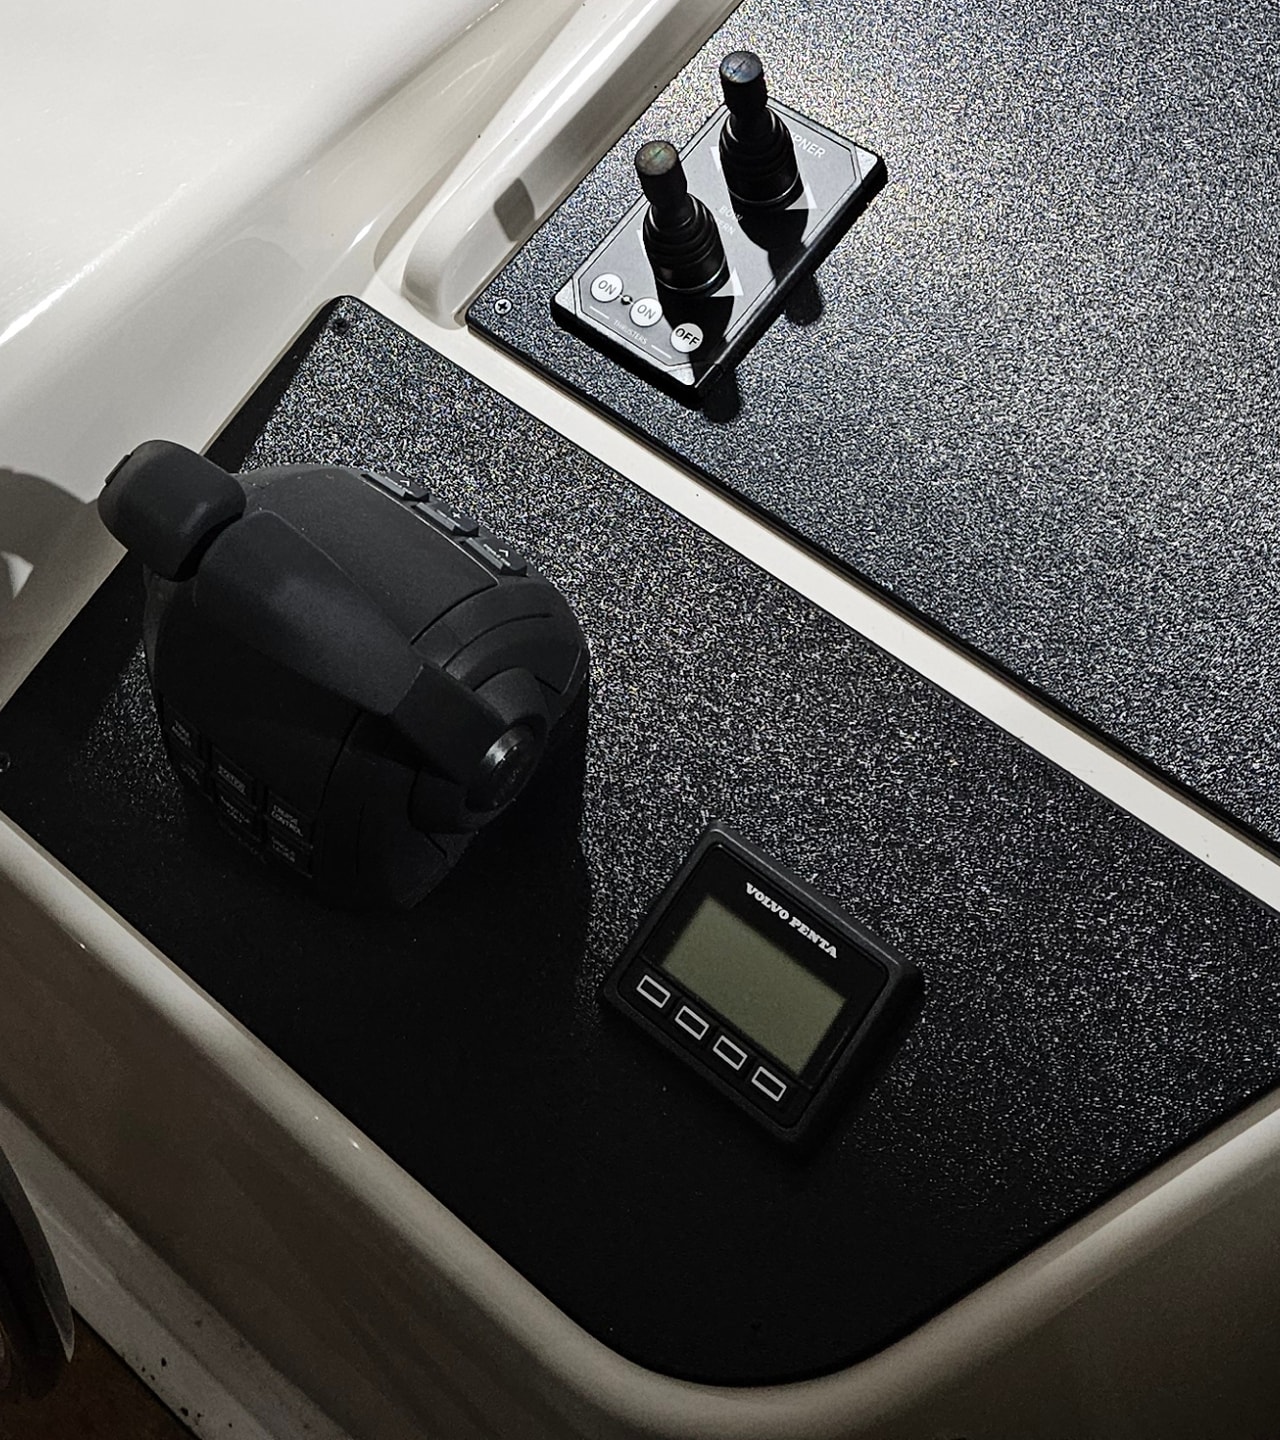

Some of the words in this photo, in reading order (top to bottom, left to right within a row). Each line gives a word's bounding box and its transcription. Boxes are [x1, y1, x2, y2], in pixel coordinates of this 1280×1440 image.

[597, 278, 617, 296] ON
[636, 303, 657, 320] ON
[675, 327, 701, 347] OFF
[745, 881, 790, 921] VOLVO
[788, 916, 838, 959] PENTA
